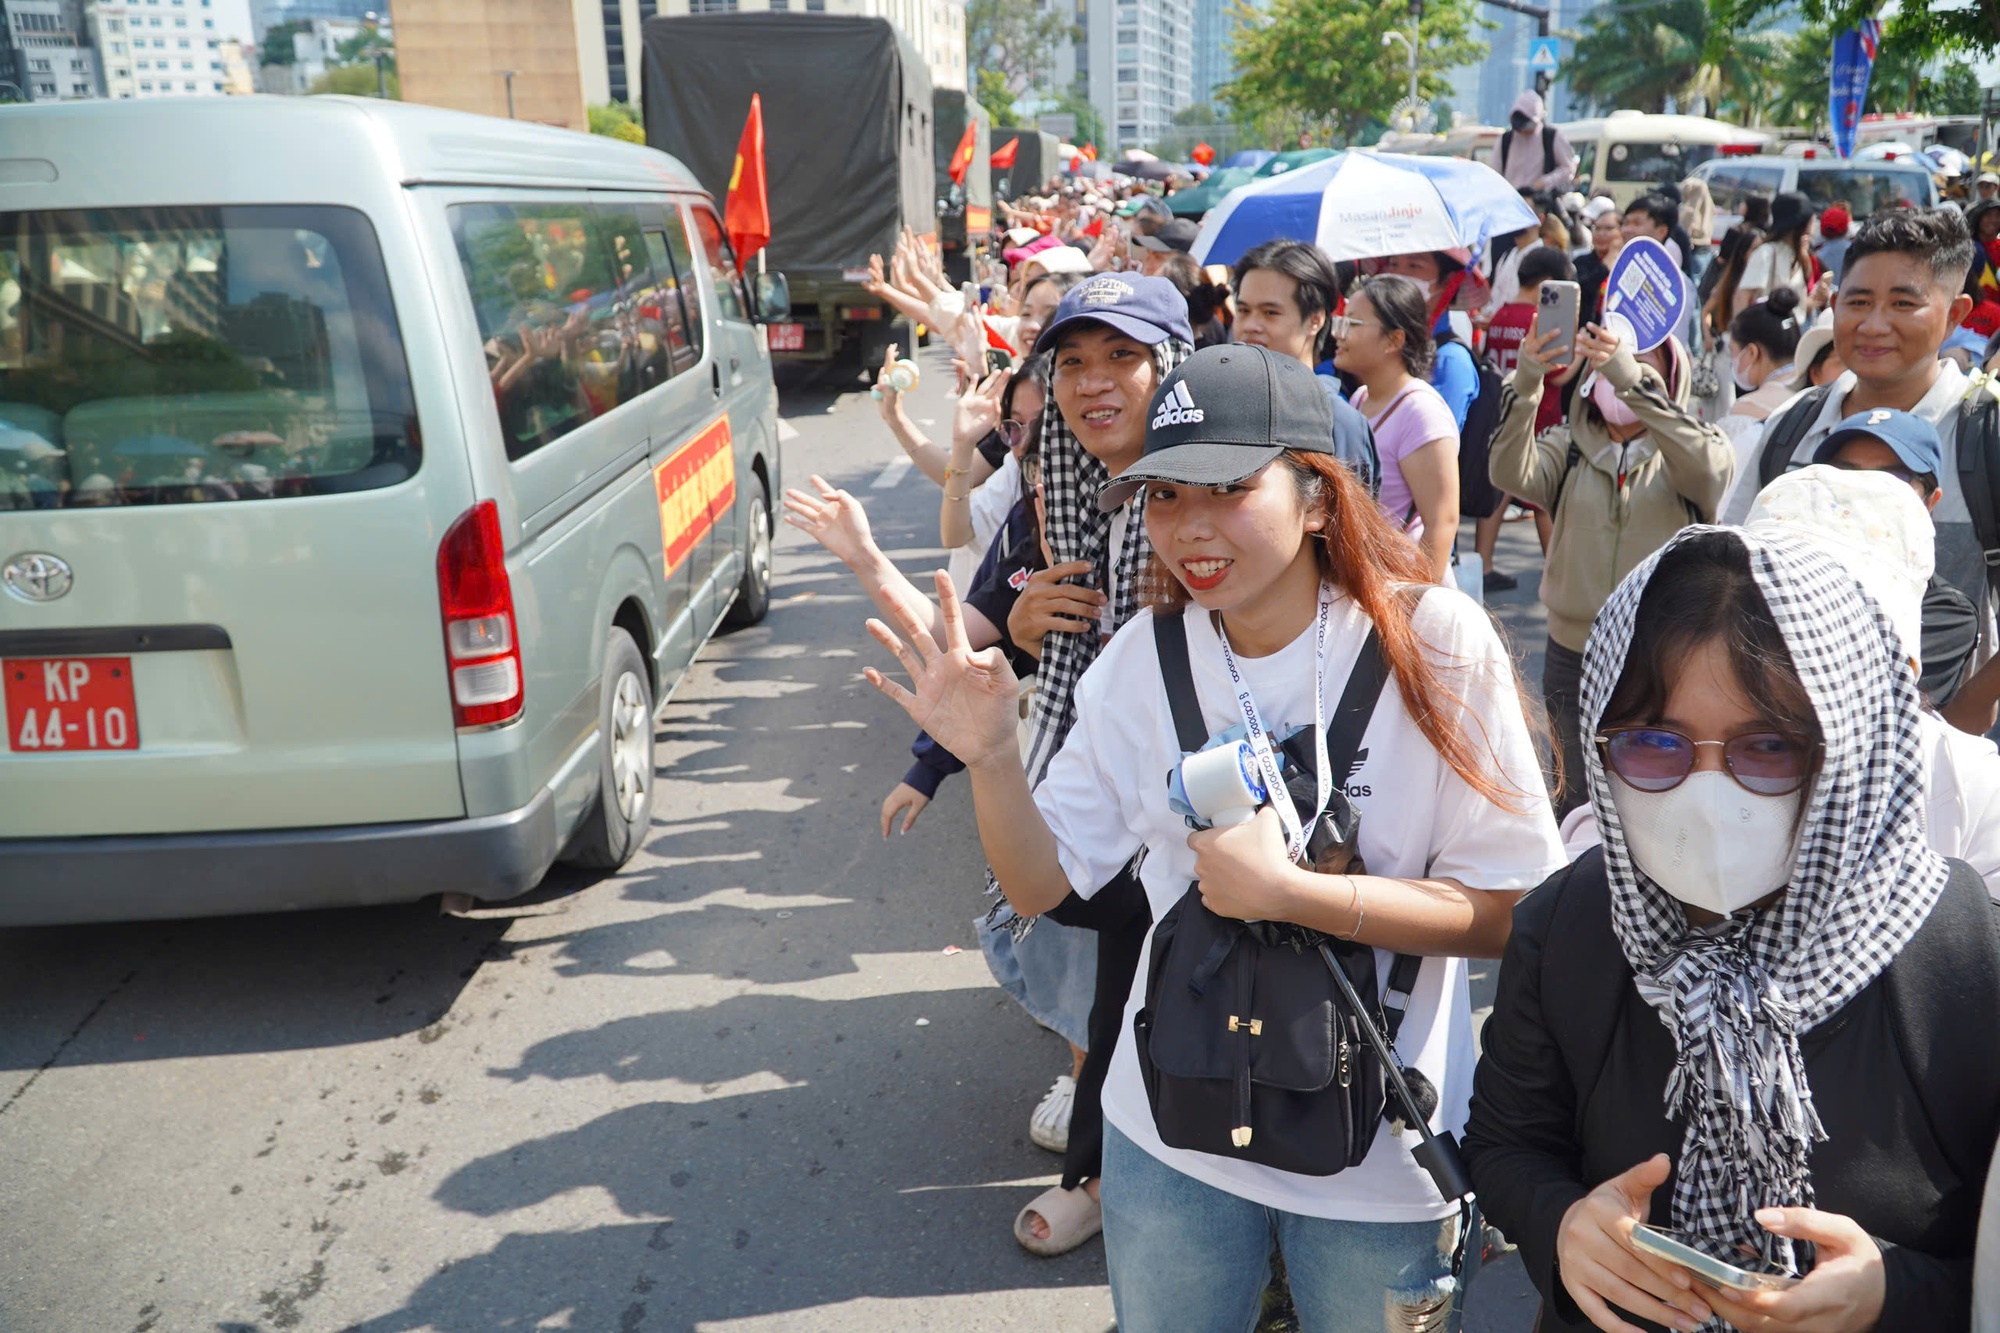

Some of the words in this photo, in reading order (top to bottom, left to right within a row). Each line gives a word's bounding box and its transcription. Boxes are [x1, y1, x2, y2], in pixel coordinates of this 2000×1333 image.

[1152, 406, 1205, 431] adidas
[1867, 410, 1892, 425] P
[43, 661, 91, 702] KP
[19, 706, 128, 748] 44-10
[1344, 782, 1372, 797] das
